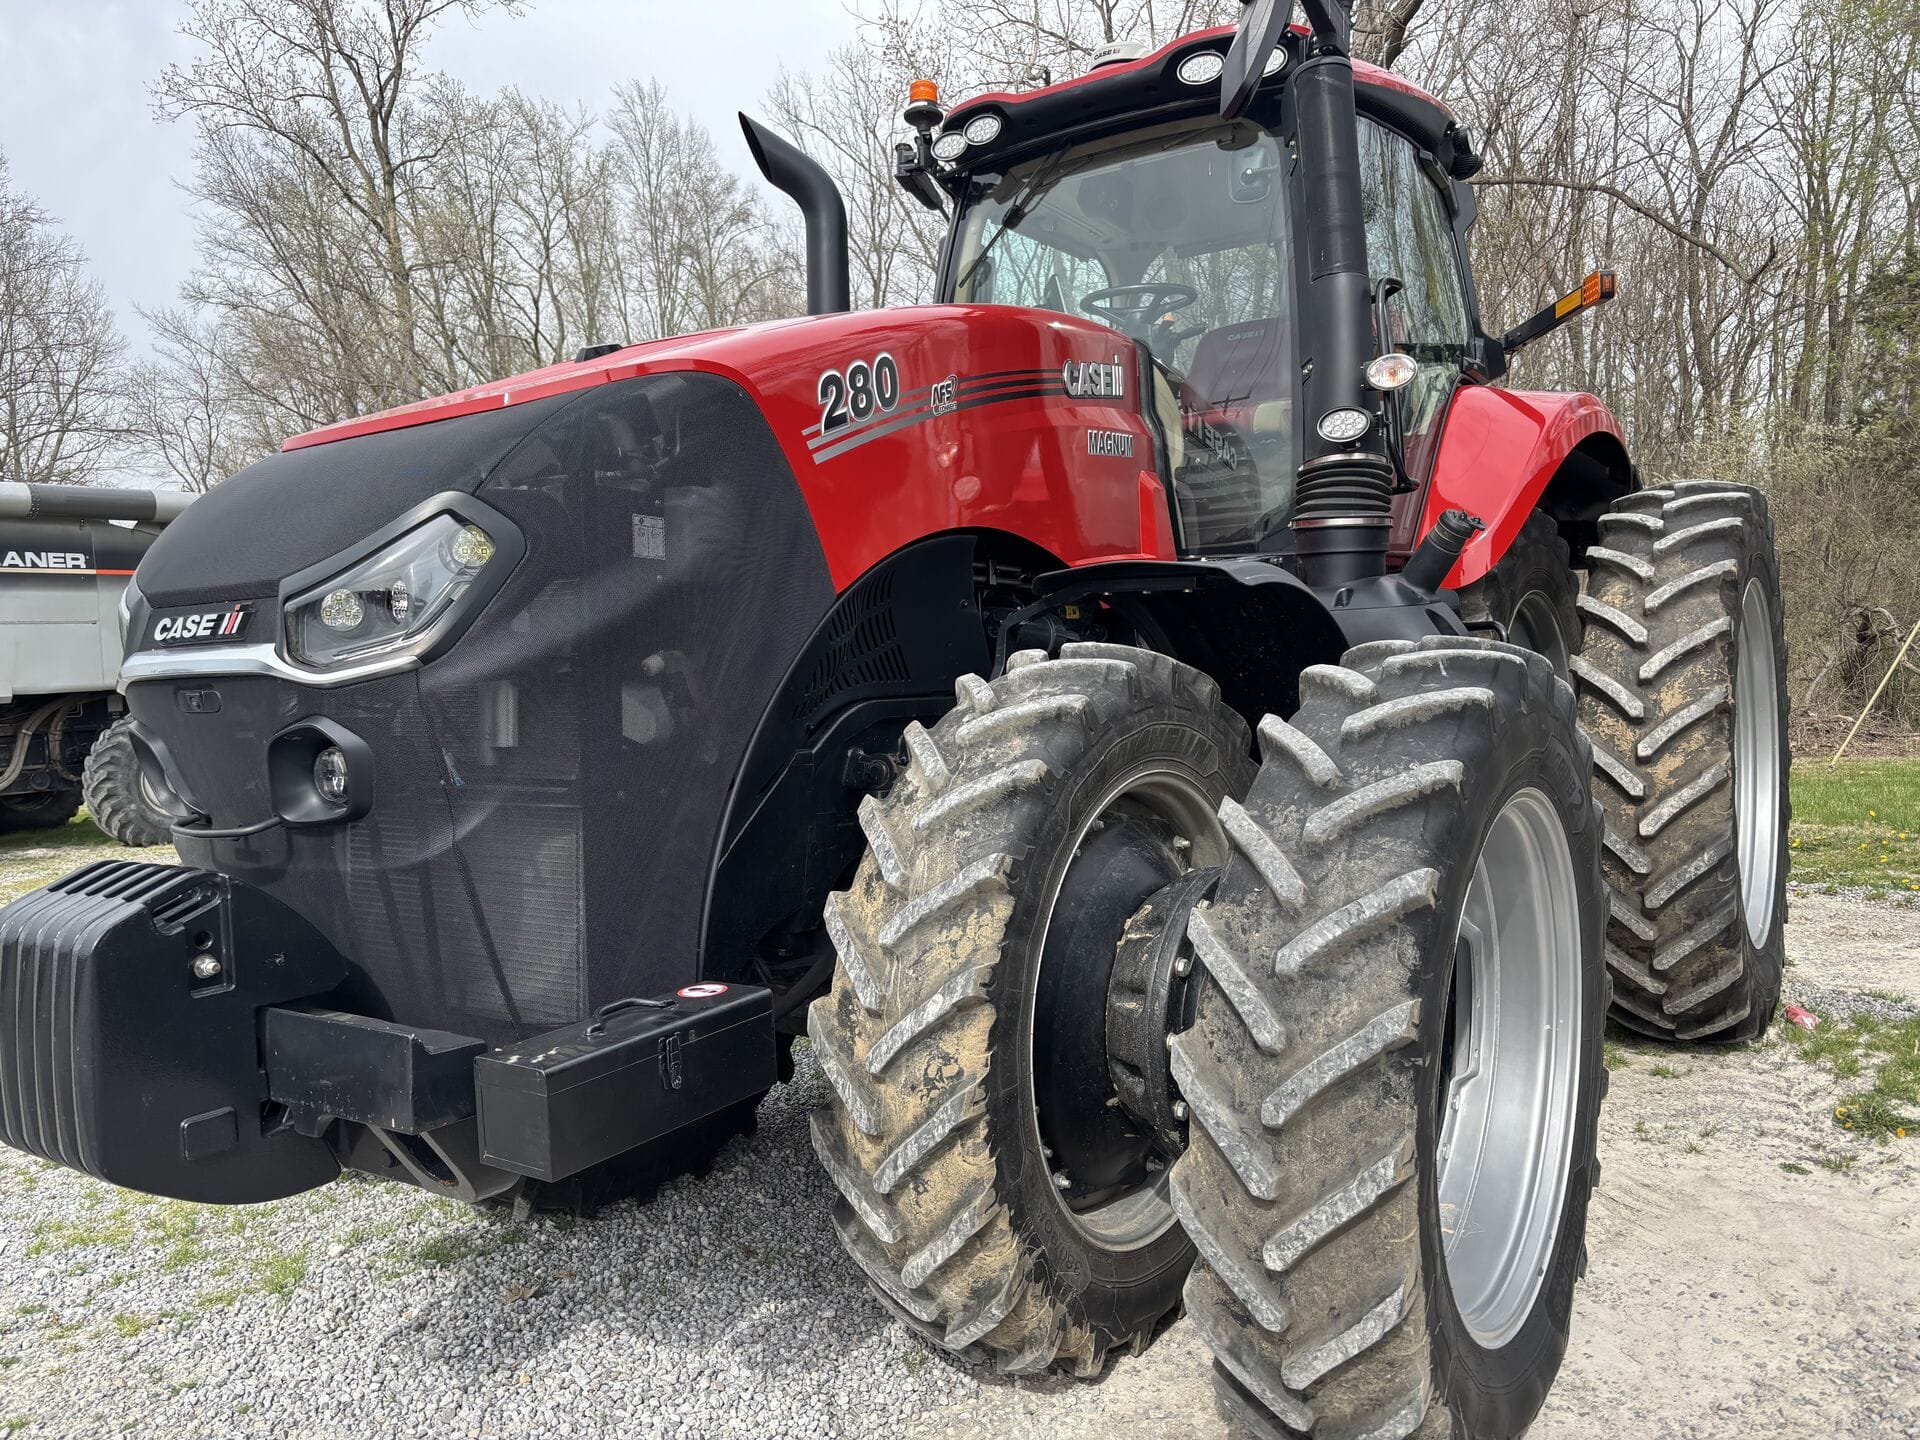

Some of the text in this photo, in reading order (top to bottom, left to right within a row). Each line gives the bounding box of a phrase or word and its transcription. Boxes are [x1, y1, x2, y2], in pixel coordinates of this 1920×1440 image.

[818, 352, 899, 436] 280
[931, 380, 952, 407] AFS
[1087, 429, 1134, 458] MAGNUM
[0, 551, 86, 569] ANER
[154, 614, 218, 641] CASE
